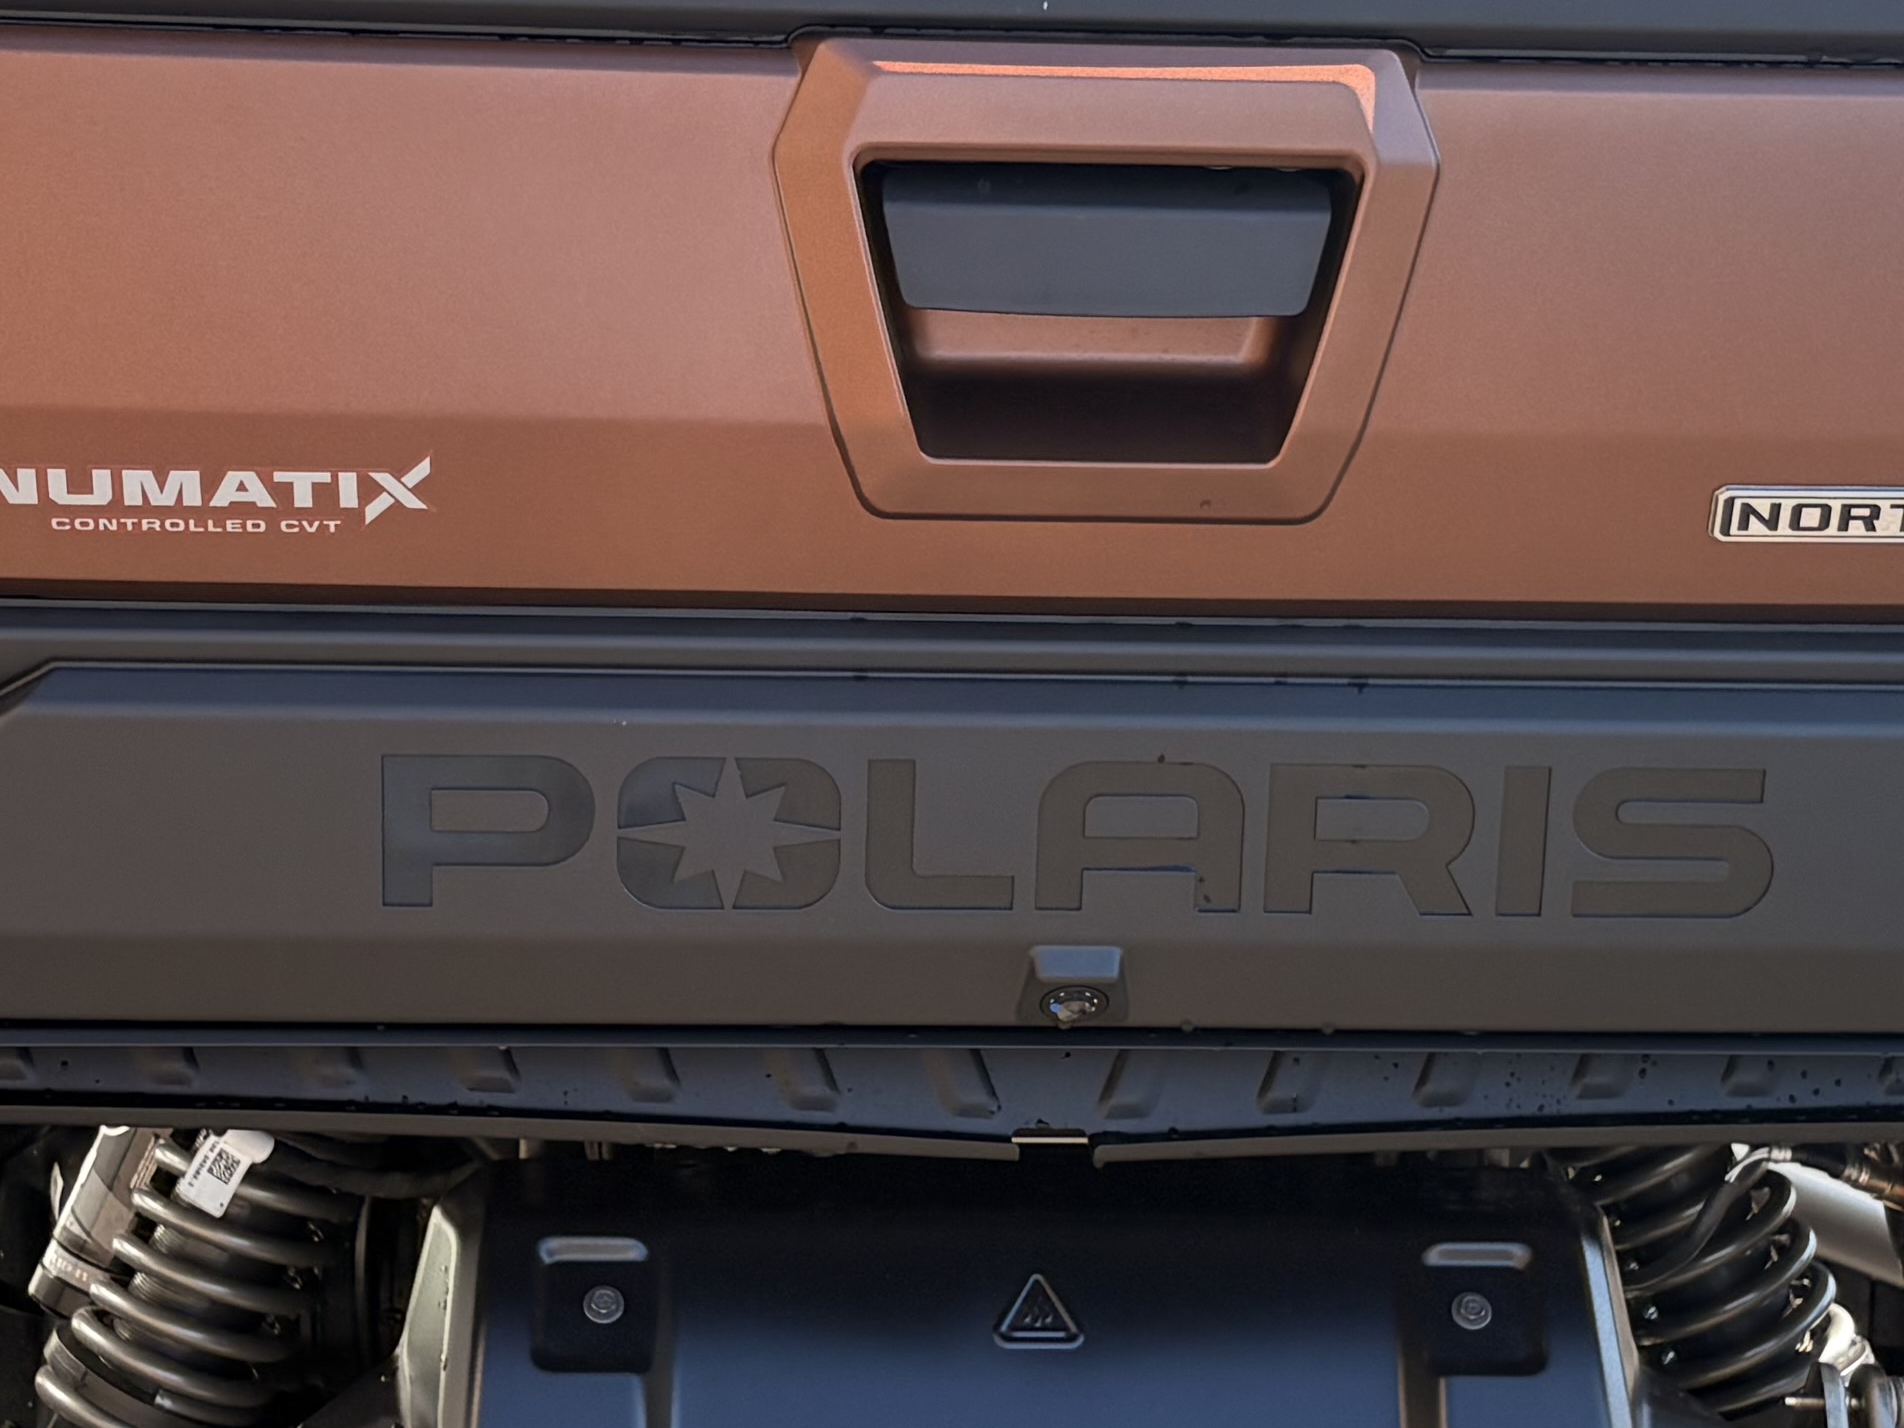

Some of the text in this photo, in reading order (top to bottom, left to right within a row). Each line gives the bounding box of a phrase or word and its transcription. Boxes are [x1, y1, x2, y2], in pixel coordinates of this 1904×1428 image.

[51, 516, 342, 534] CONTROLLED CVT
[381, 753, 1775, 919] POLARIS
